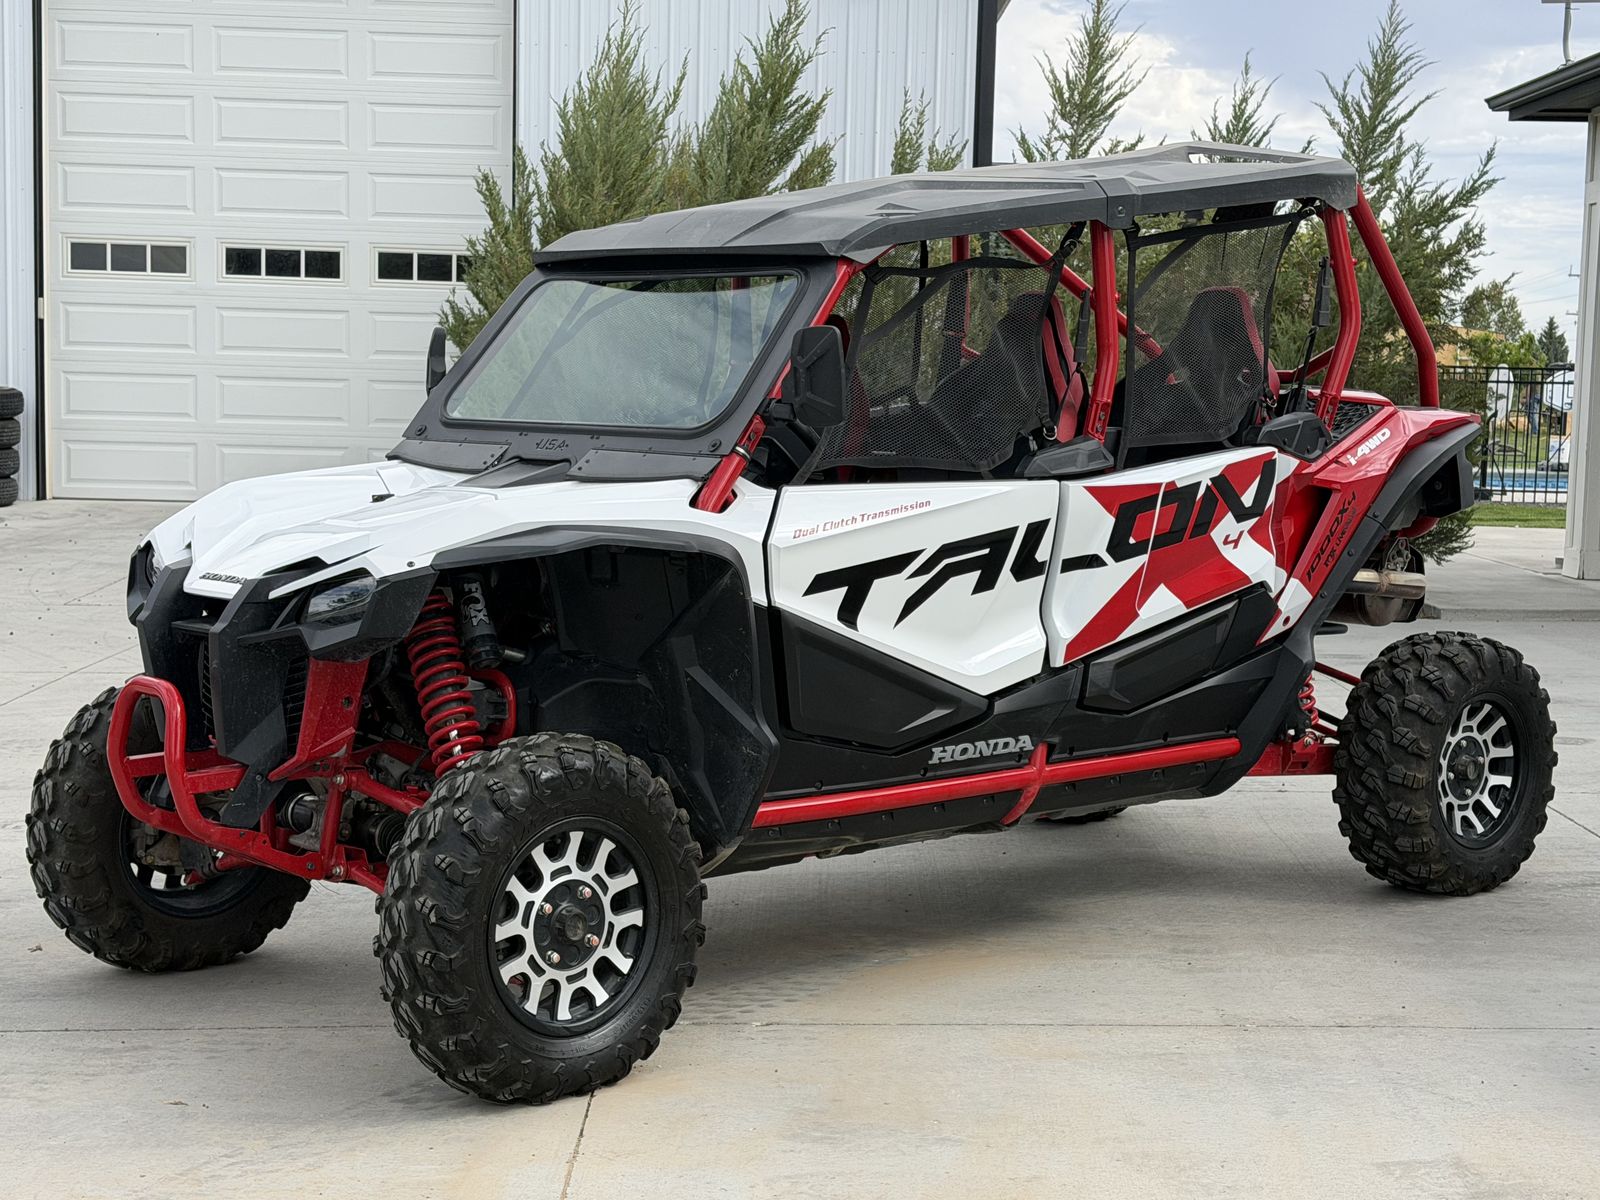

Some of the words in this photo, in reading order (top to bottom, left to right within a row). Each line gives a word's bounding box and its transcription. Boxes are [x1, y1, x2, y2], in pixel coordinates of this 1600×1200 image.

[536, 438, 566, 451] USA
[1347, 428, 1391, 466] i-4WD
[792, 524, 819, 539] Dual
[822, 515, 858, 532] Clutch
[859, 500, 931, 523] Transmission
[802, 458, 1278, 632] TALON
[1222, 529, 1245, 550] 4
[928, 734, 1035, 765] HONDA
